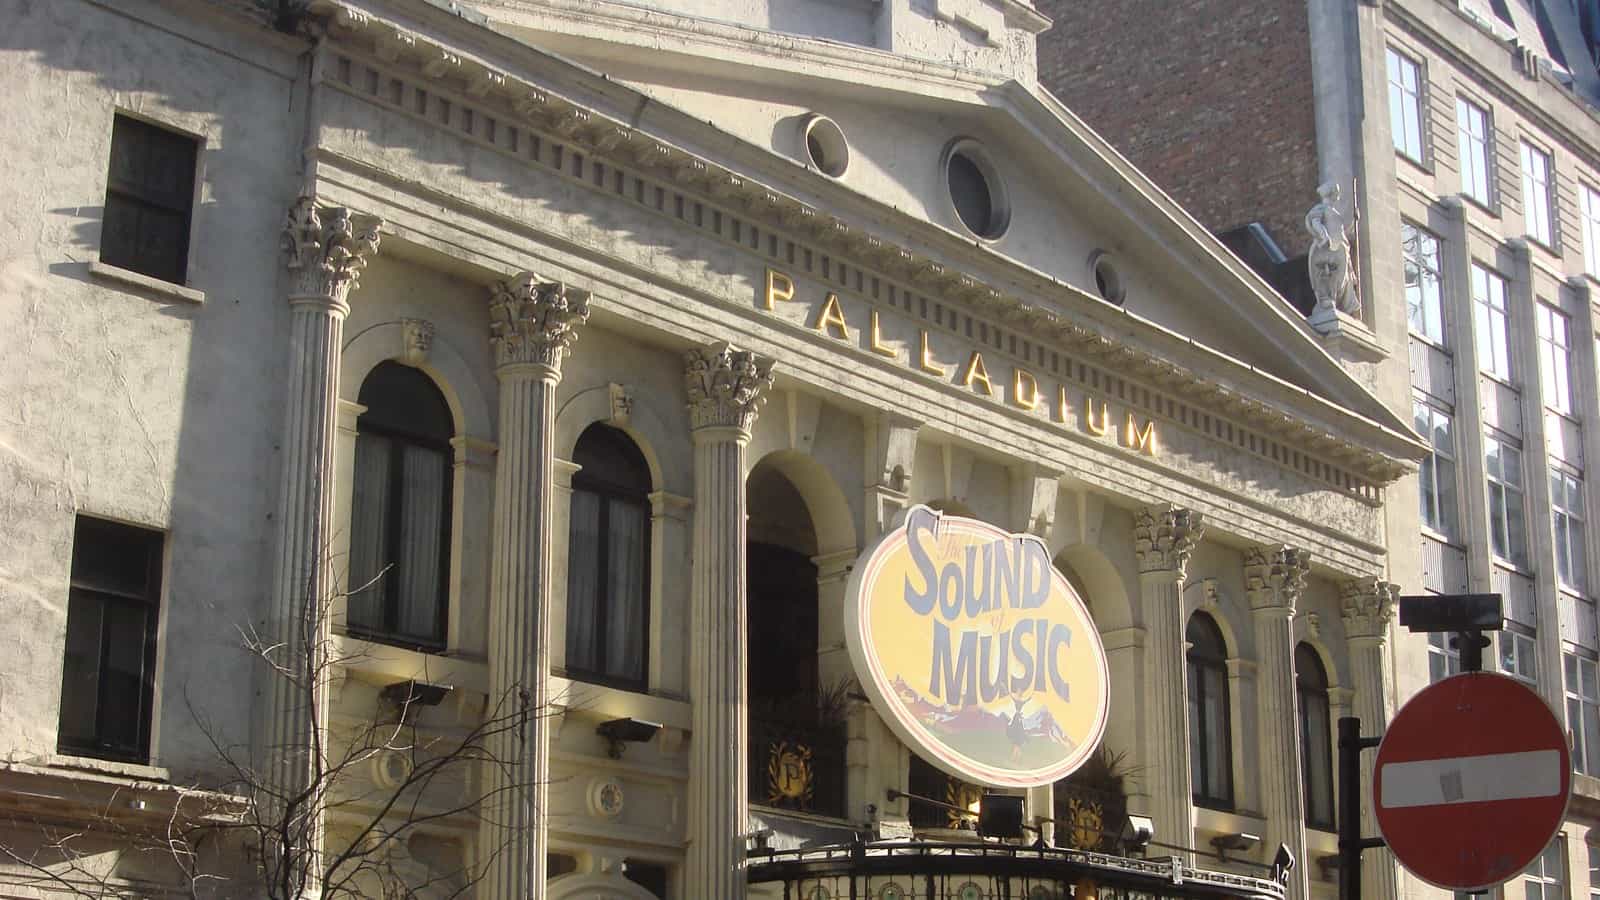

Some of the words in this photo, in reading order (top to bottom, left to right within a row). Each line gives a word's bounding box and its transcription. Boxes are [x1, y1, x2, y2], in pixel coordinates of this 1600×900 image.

[764, 266, 1157, 456] PALLADIUM
[904, 507, 1051, 621] SOUND
[929, 618, 1072, 705] MUSIC
